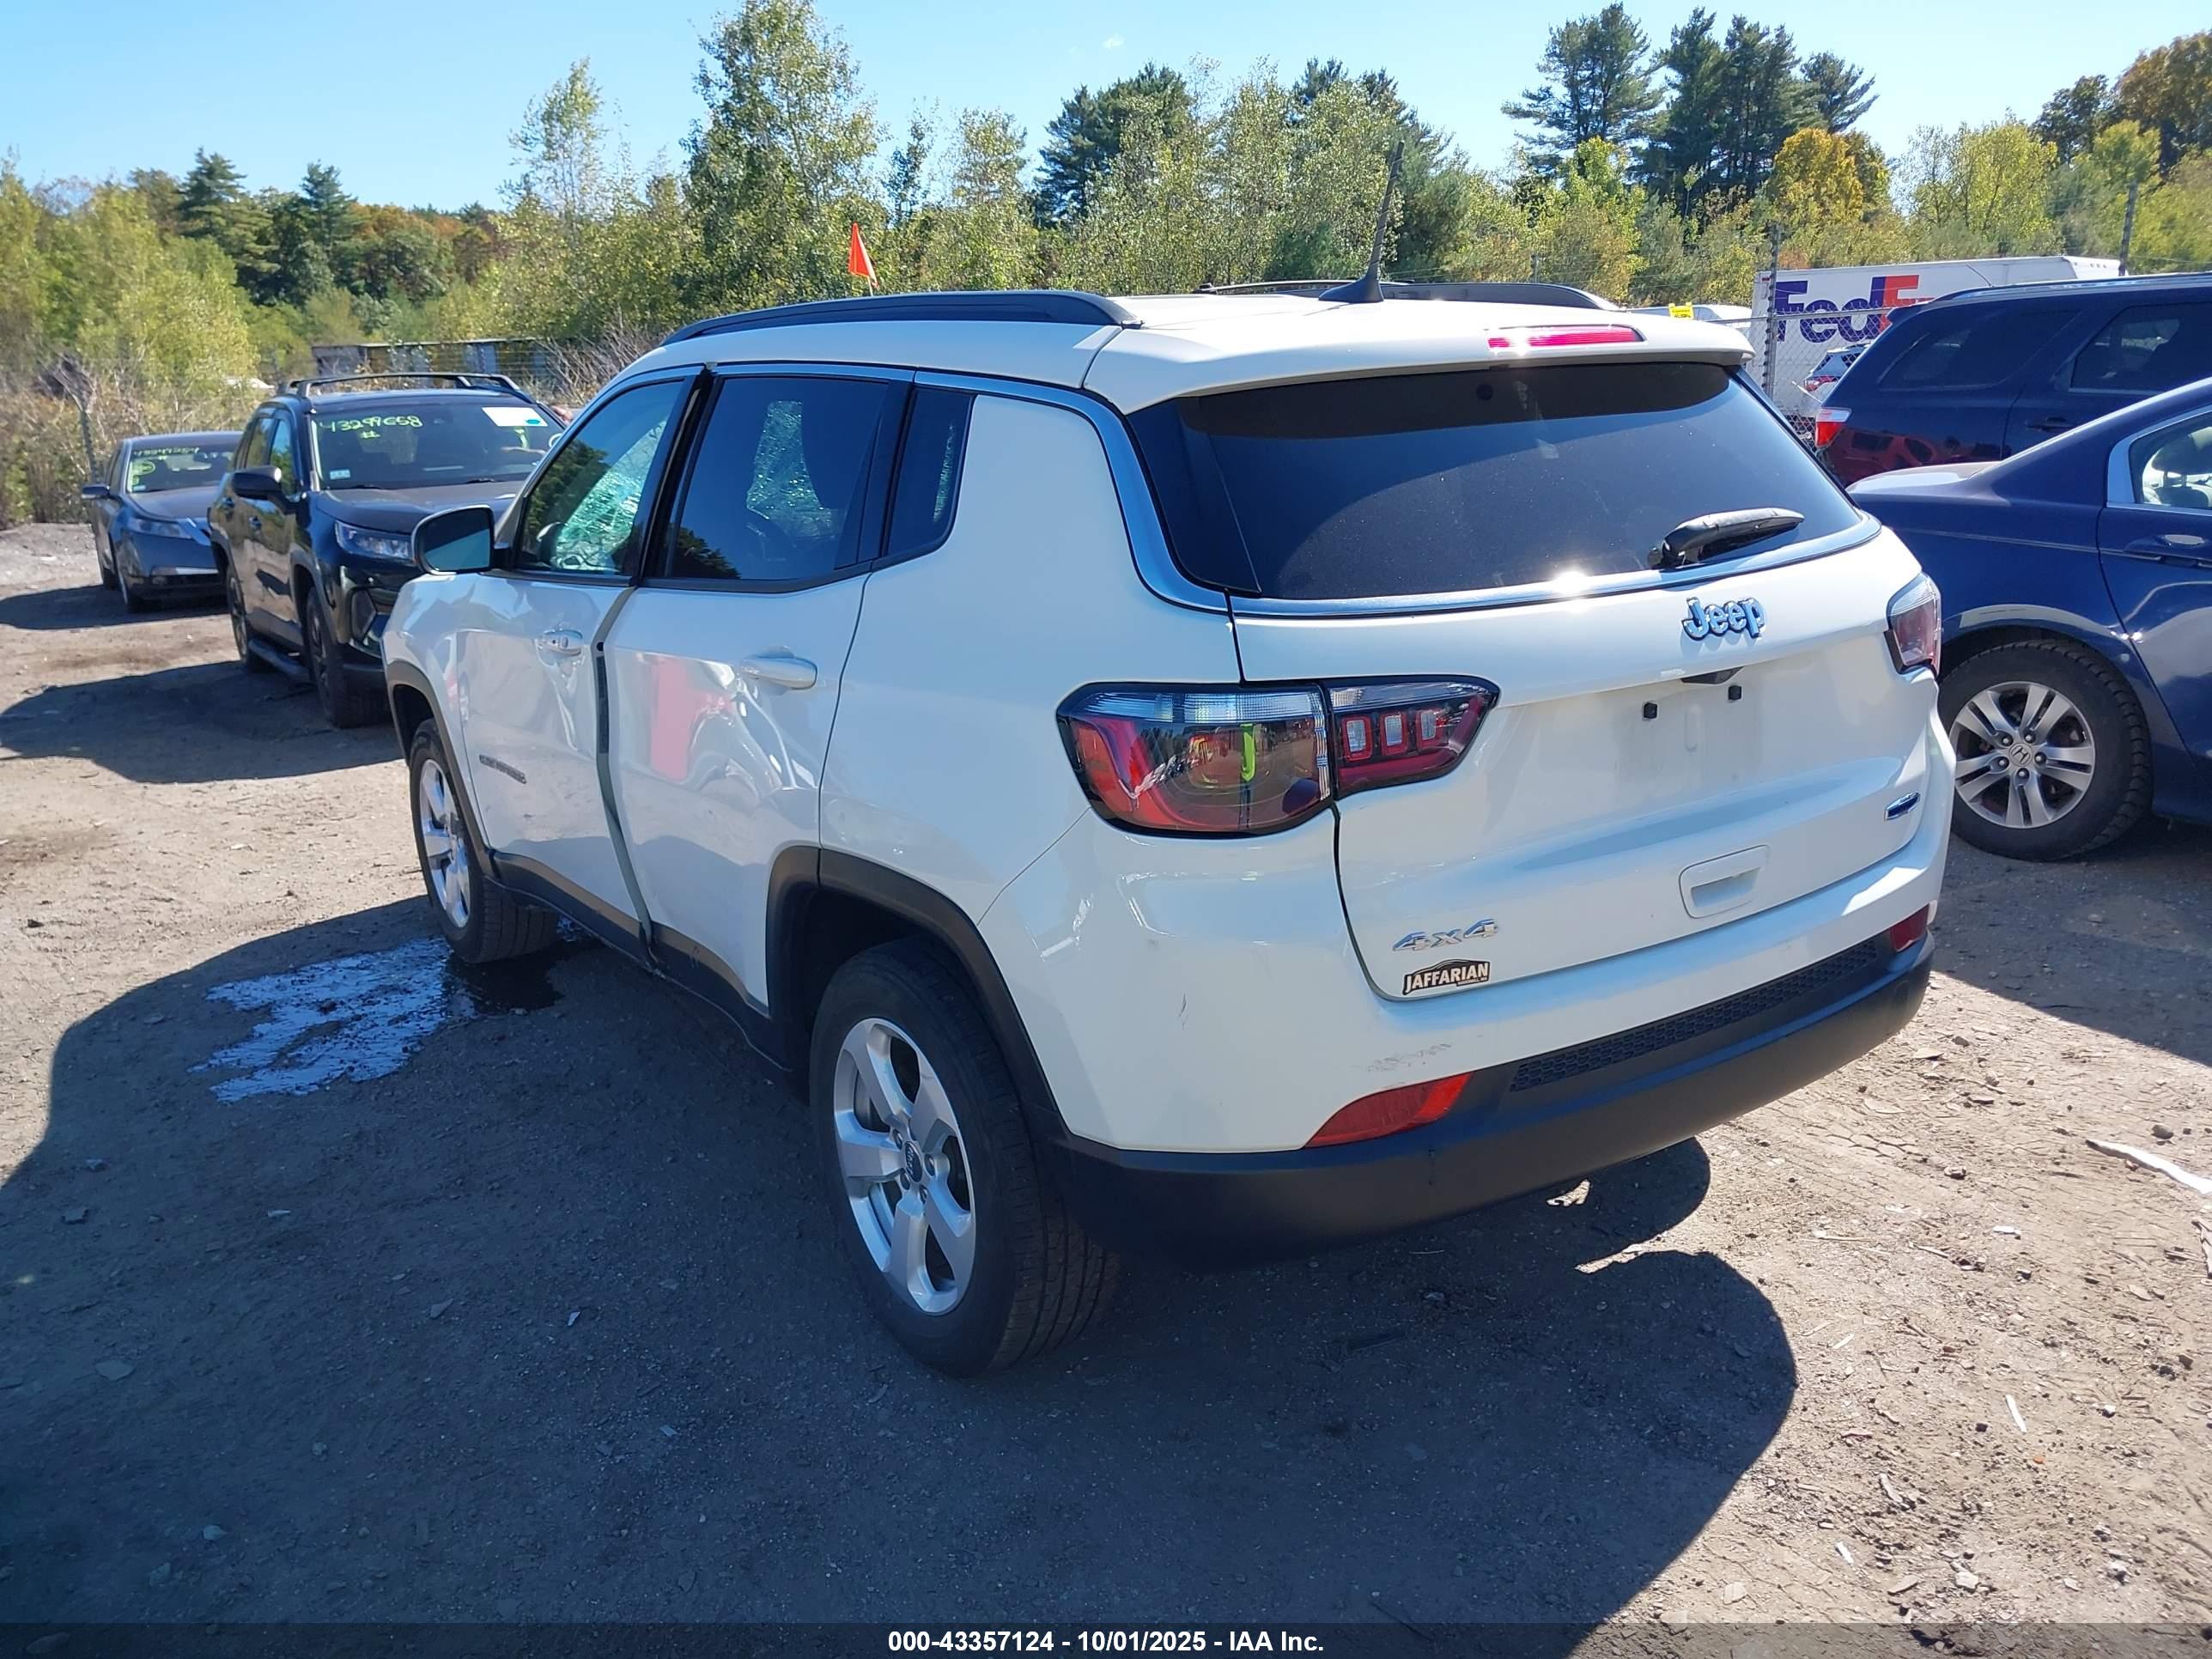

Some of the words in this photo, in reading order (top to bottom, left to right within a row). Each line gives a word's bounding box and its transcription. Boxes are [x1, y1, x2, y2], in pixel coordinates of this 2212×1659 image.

[1775, 275, 1936, 343] FedE
[1681, 597, 1765, 641] Jeep
[1404, 963, 1488, 994] JAFFARIAN
